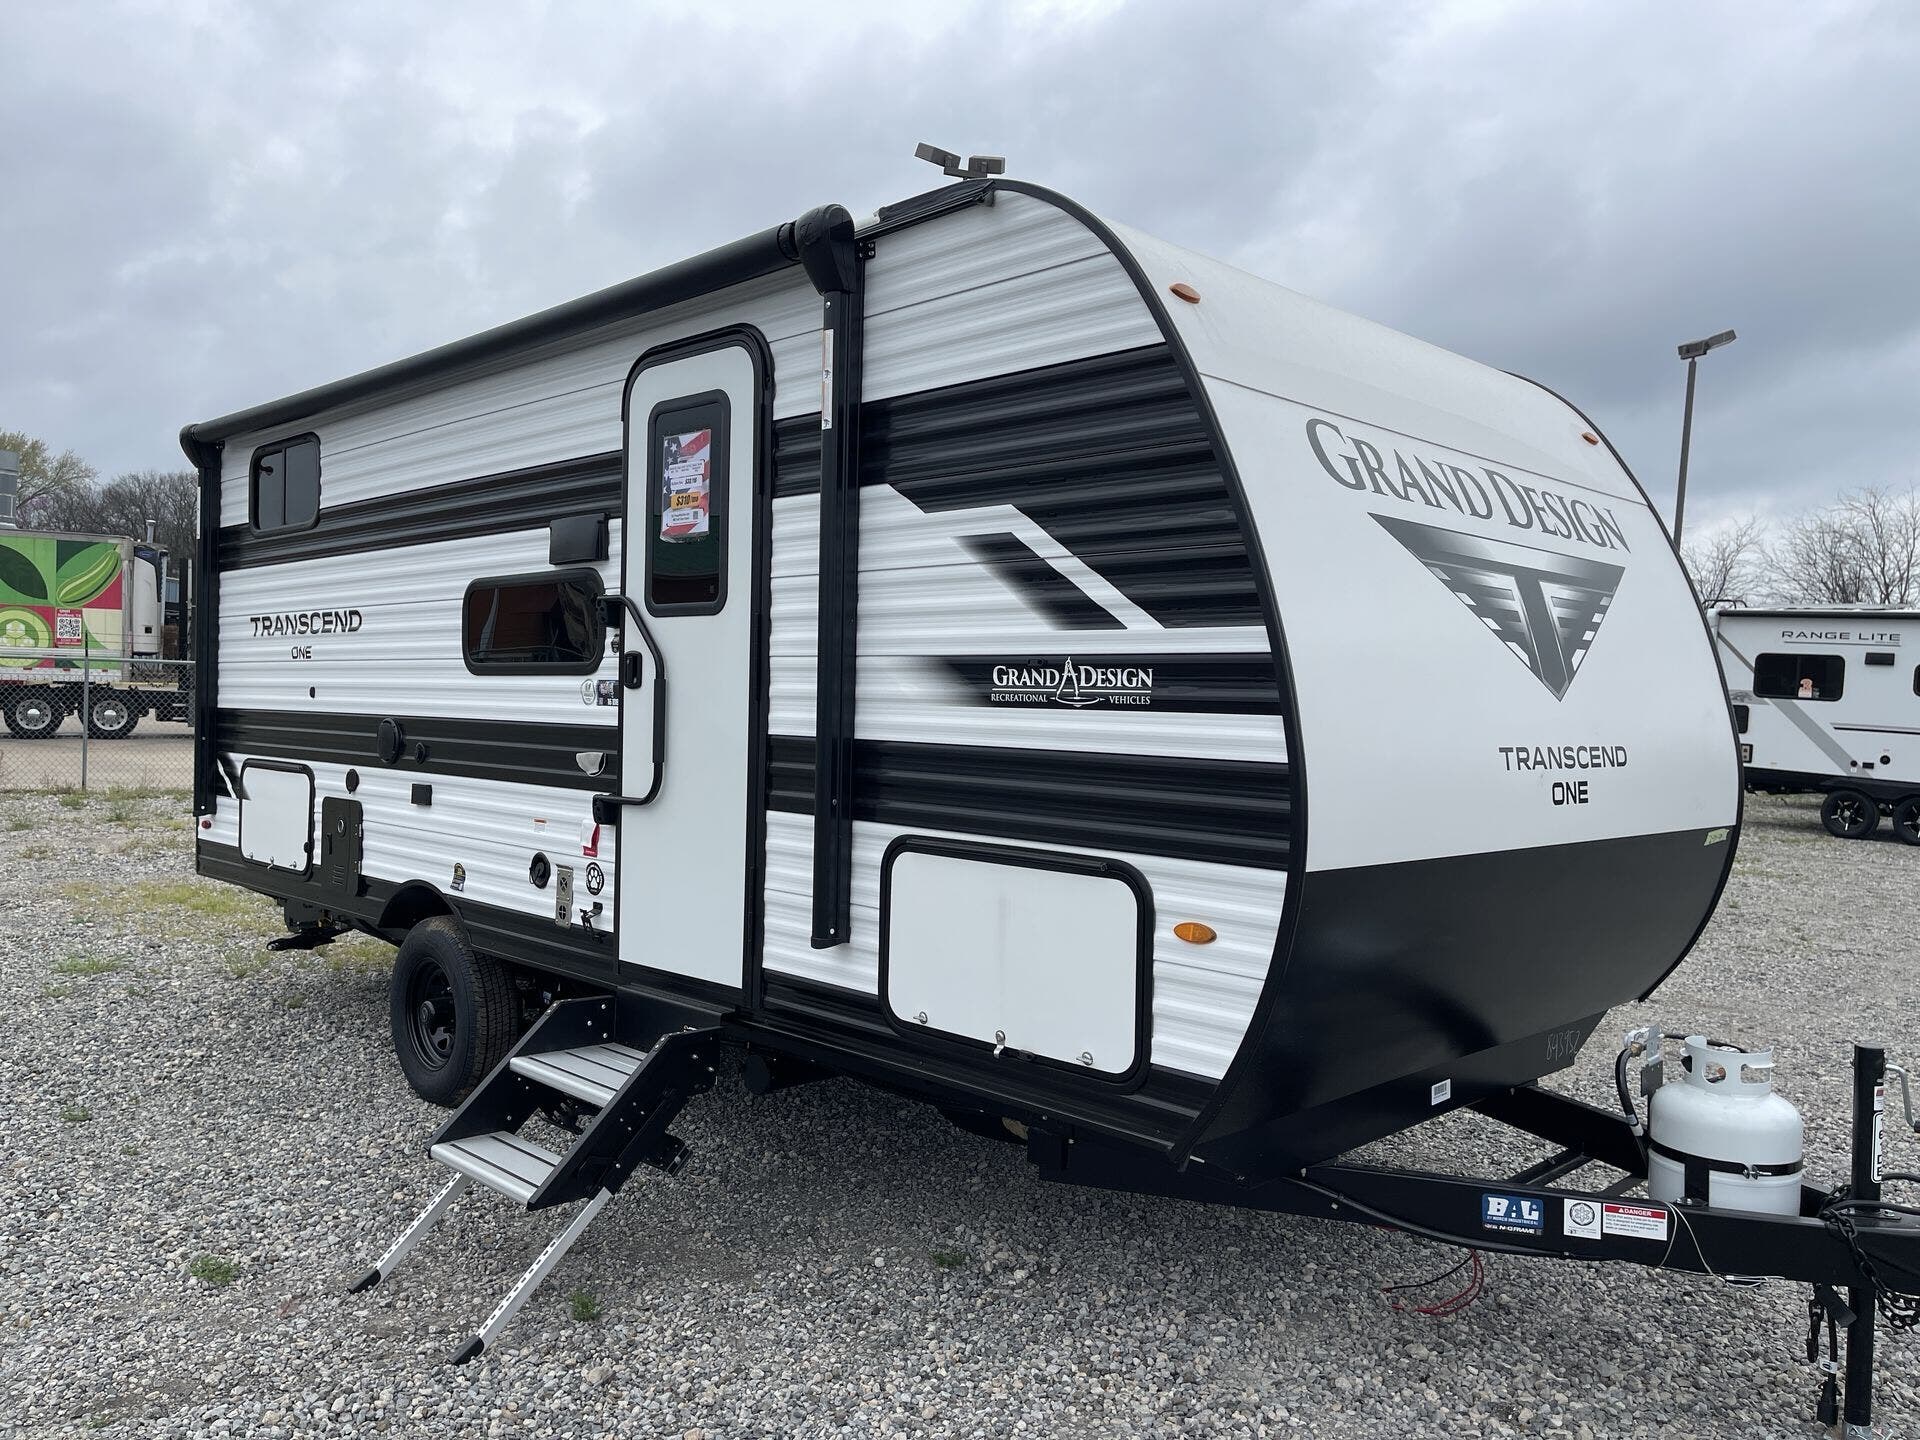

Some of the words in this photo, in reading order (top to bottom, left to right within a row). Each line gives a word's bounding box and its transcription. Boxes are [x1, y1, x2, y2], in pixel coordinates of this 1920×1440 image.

[1305, 418, 1493, 519] GRAND
[1479, 466, 1631, 553] DESIGN
[250, 609, 362, 637] TRANSCEND
[1782, 631, 1851, 640] RANGE
[1859, 632, 1901, 642] LITE
[291, 645, 312, 659] ONE
[992, 665, 1060, 687] GRAND
[1078, 665, 1154, 688] DESIGN
[991, 693, 1048, 703] RECREATIONAL
[1109, 695, 1151, 705] VEHICLES
[1498, 745, 1628, 771] TRANSCEND
[1552, 781, 1589, 806] ONE
[1487, 1197, 1539, 1221] BAL
[1624, 1208, 1653, 1217] DANGER
